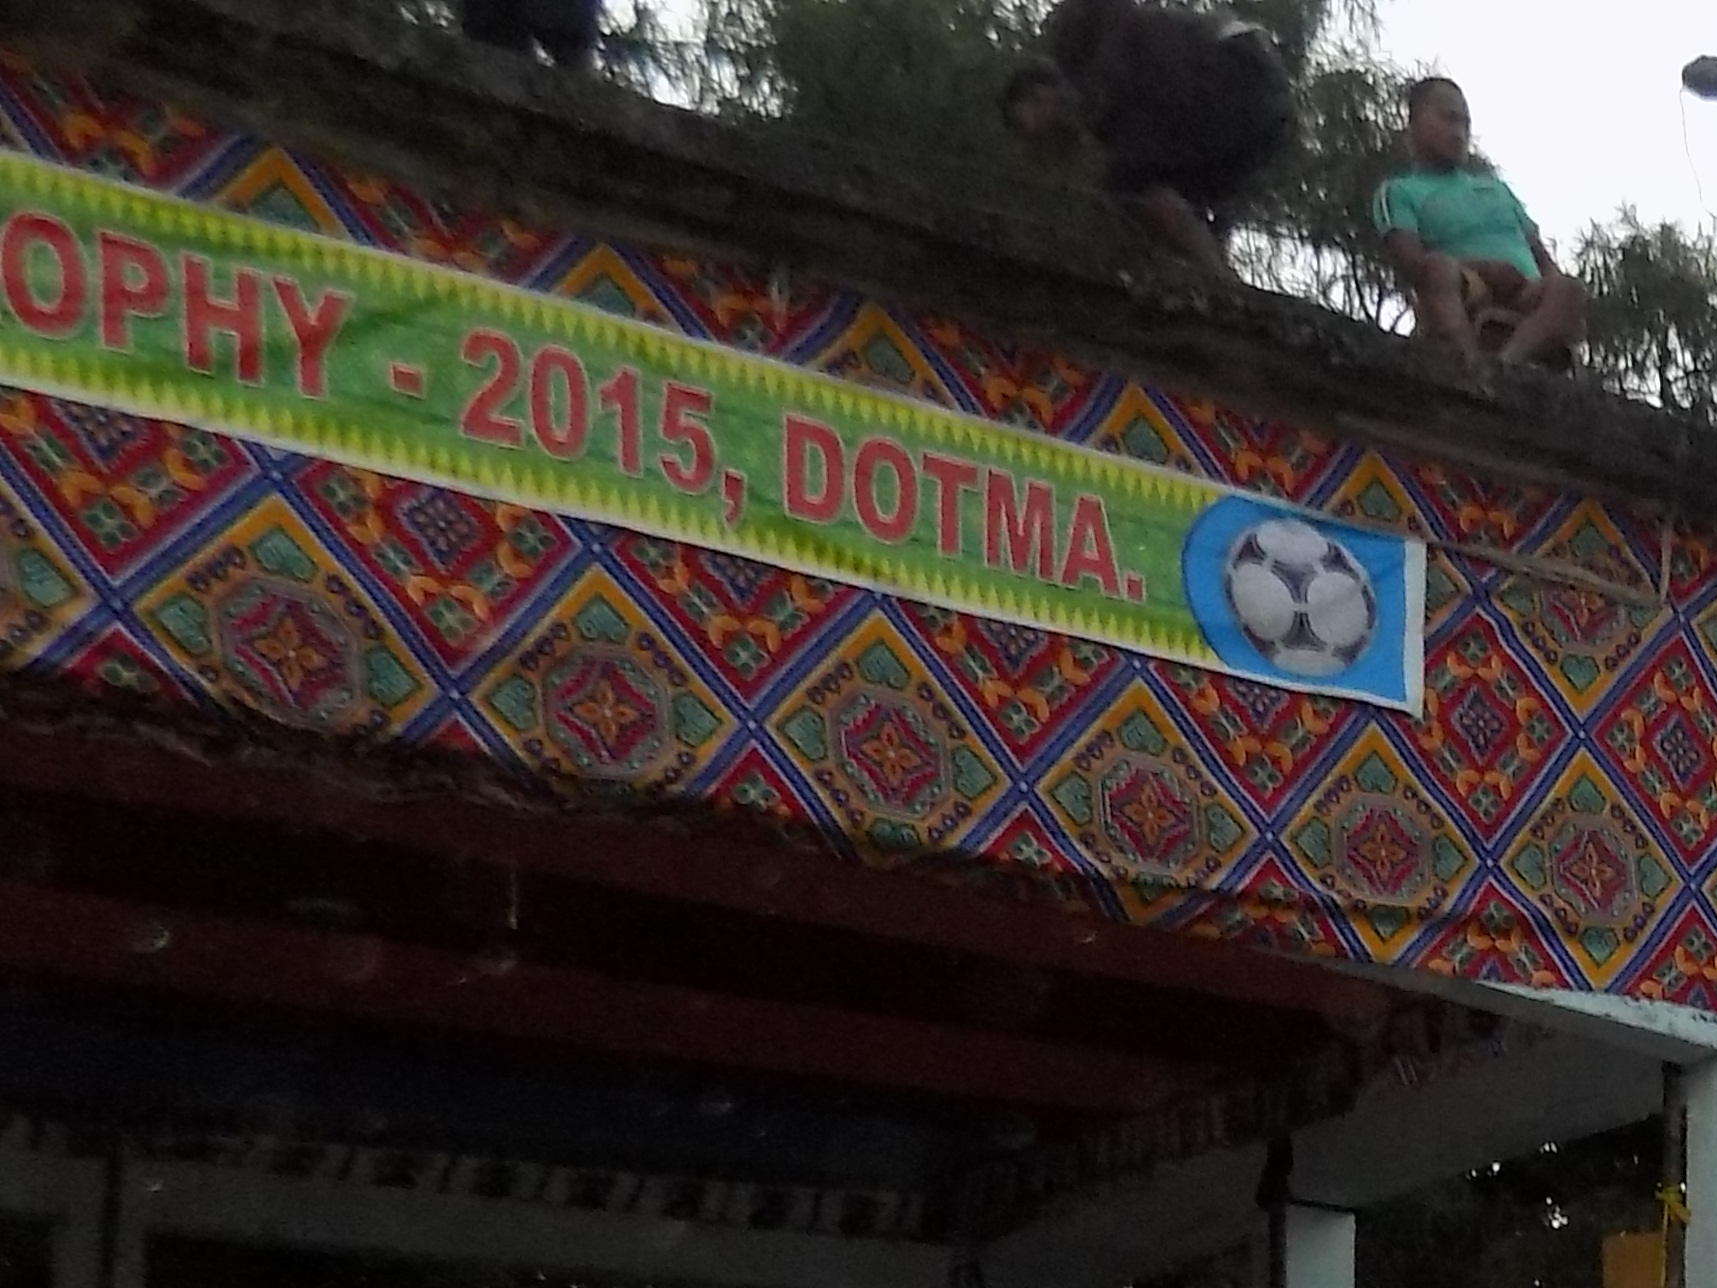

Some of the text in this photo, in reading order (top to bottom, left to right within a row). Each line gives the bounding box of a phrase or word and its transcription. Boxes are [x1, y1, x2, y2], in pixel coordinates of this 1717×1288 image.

[0, 210, 354, 400] OPHY
[461, 327, 748, 530] 2015,
[784, 413, 1147, 604] DOTMA.
